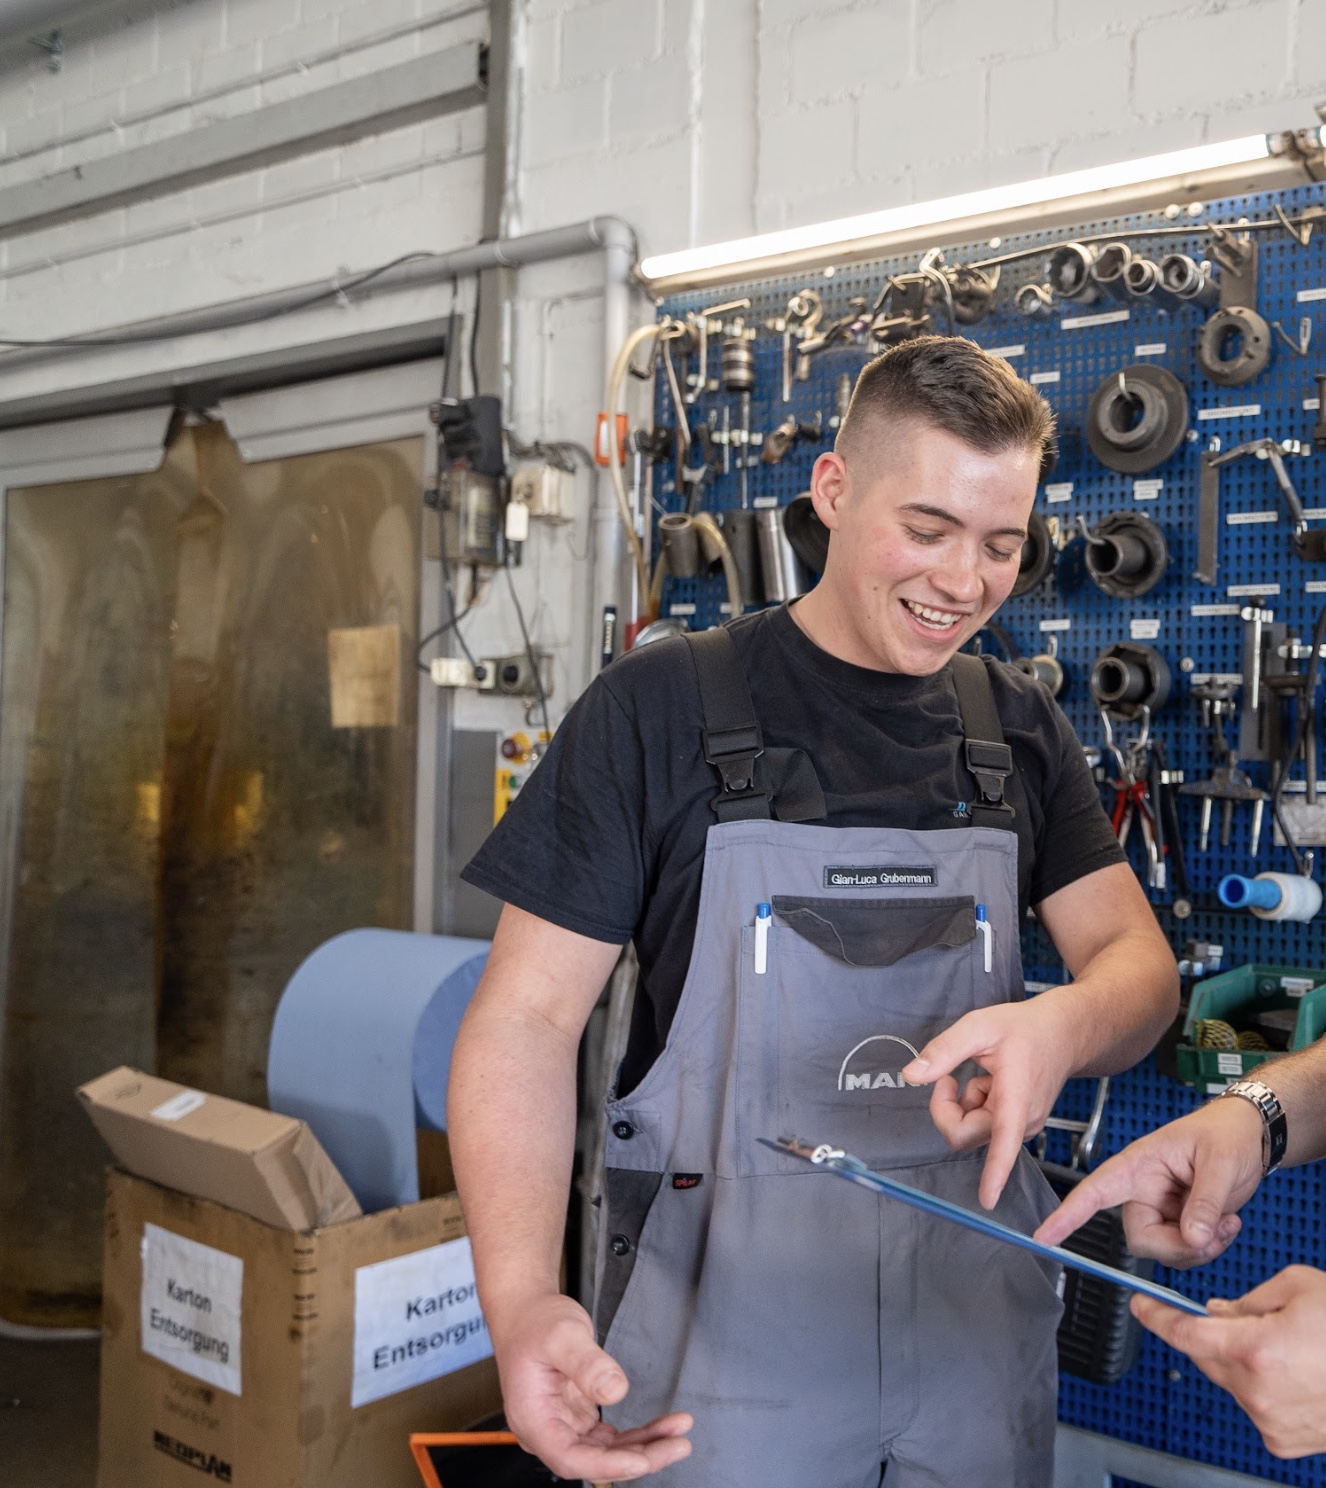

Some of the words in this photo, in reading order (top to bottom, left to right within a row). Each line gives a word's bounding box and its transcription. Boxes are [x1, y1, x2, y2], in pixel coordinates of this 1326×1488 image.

[831, 873, 877, 885] Gian-Luca
[880, 872, 932, 884] Grubenmann
[166, 1278, 212, 1313] Karton
[149, 1307, 230, 1364] Entsorgung
[373, 1314, 487, 1372] Entsorgu
